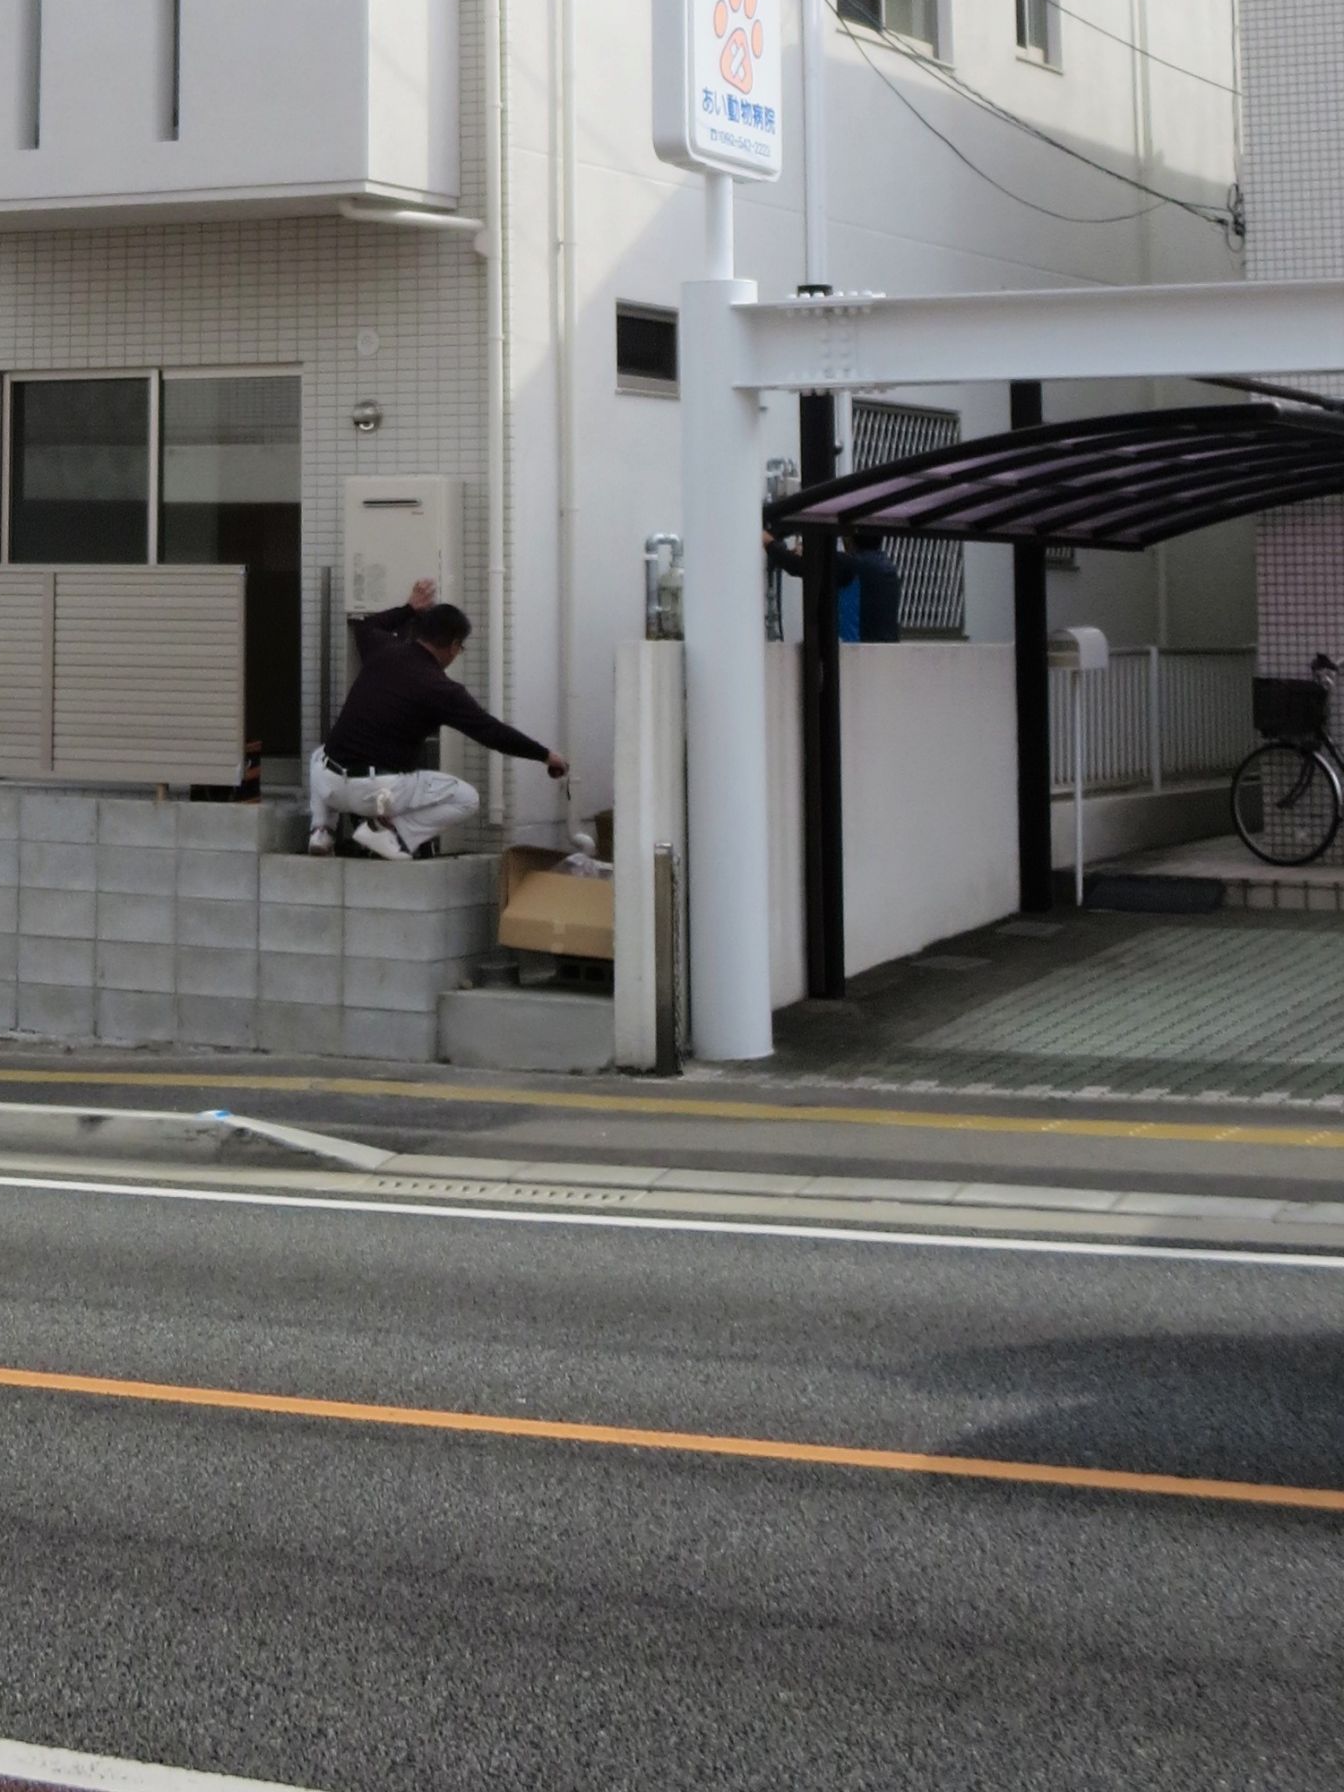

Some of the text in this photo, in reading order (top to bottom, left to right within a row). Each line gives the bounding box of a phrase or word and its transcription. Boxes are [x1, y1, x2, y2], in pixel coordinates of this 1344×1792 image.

[702, 86, 776, 136] あい動物病院
